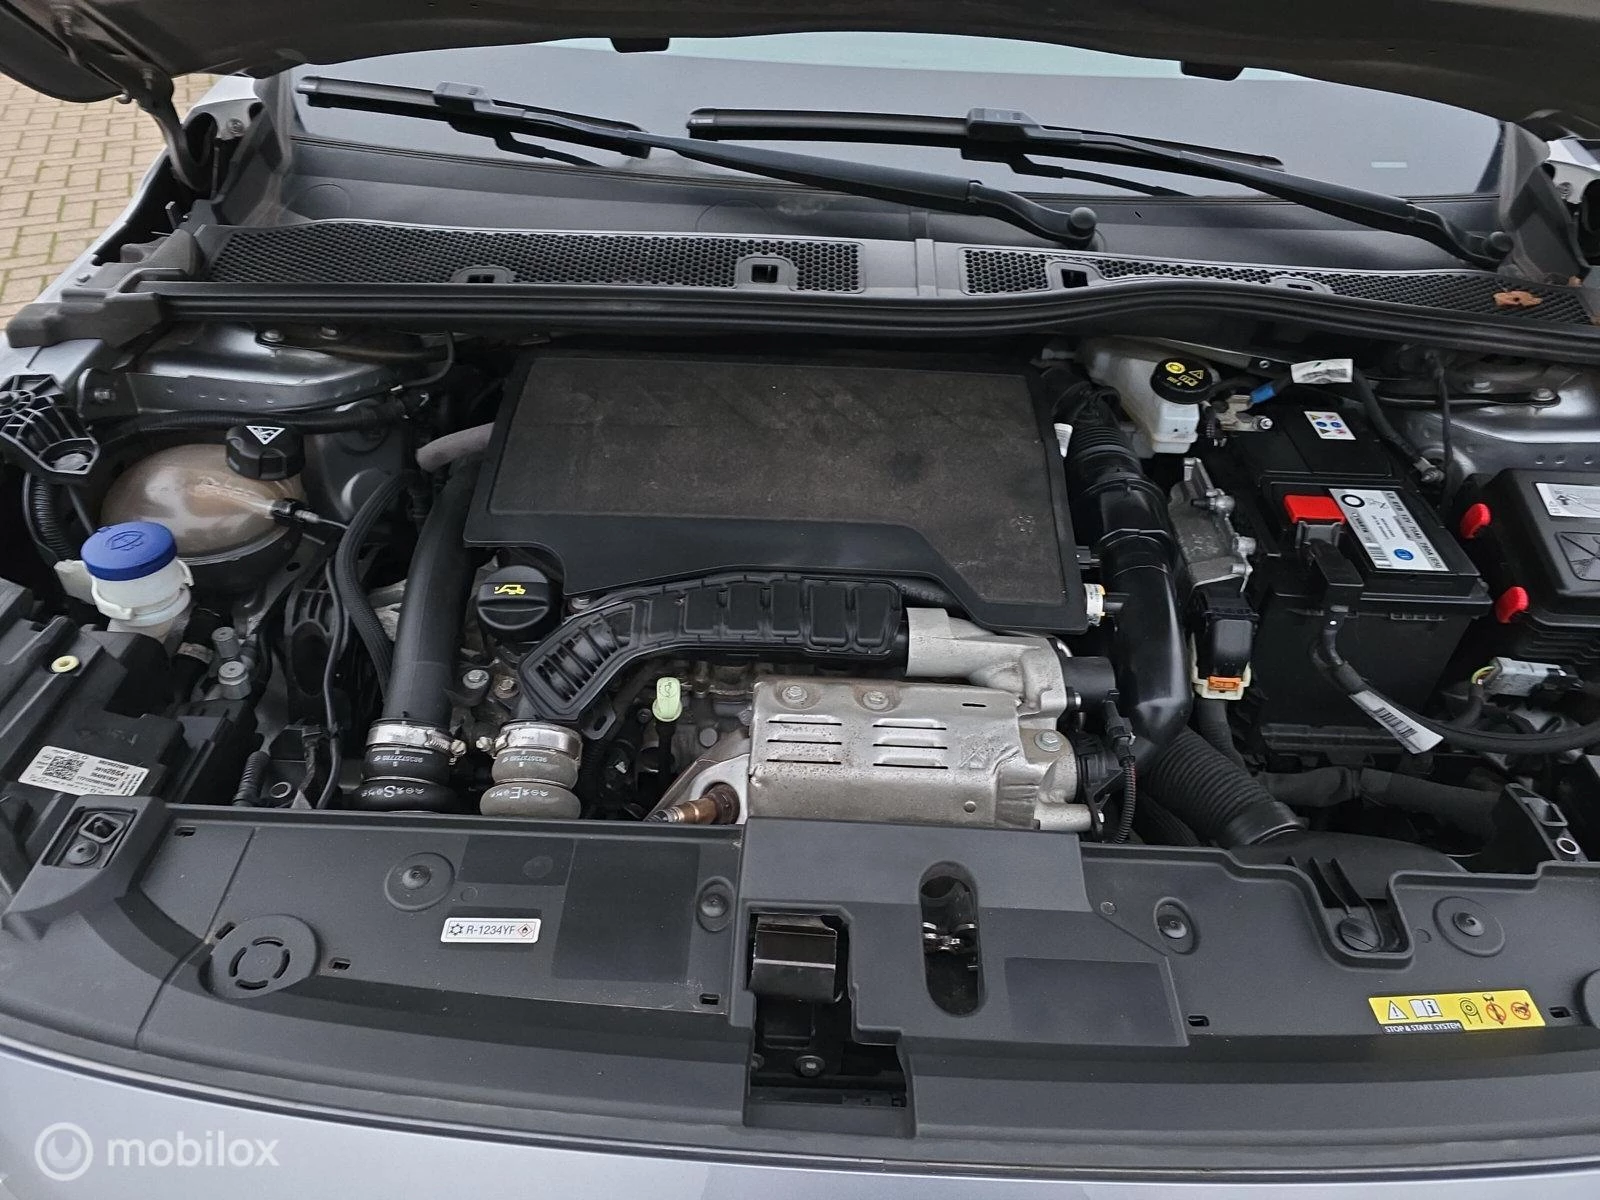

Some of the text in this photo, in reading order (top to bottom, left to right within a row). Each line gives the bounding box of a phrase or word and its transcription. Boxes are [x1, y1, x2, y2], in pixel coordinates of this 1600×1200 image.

[1401, 514, 1413, 524] 12V
[466, 925, 516, 935] R-1234YF
[1384, 1025, 1404, 1033] STOP
[1411, 1024, 1434, 1032] START
[1434, 1022, 1462, 1030] SYSTEM
